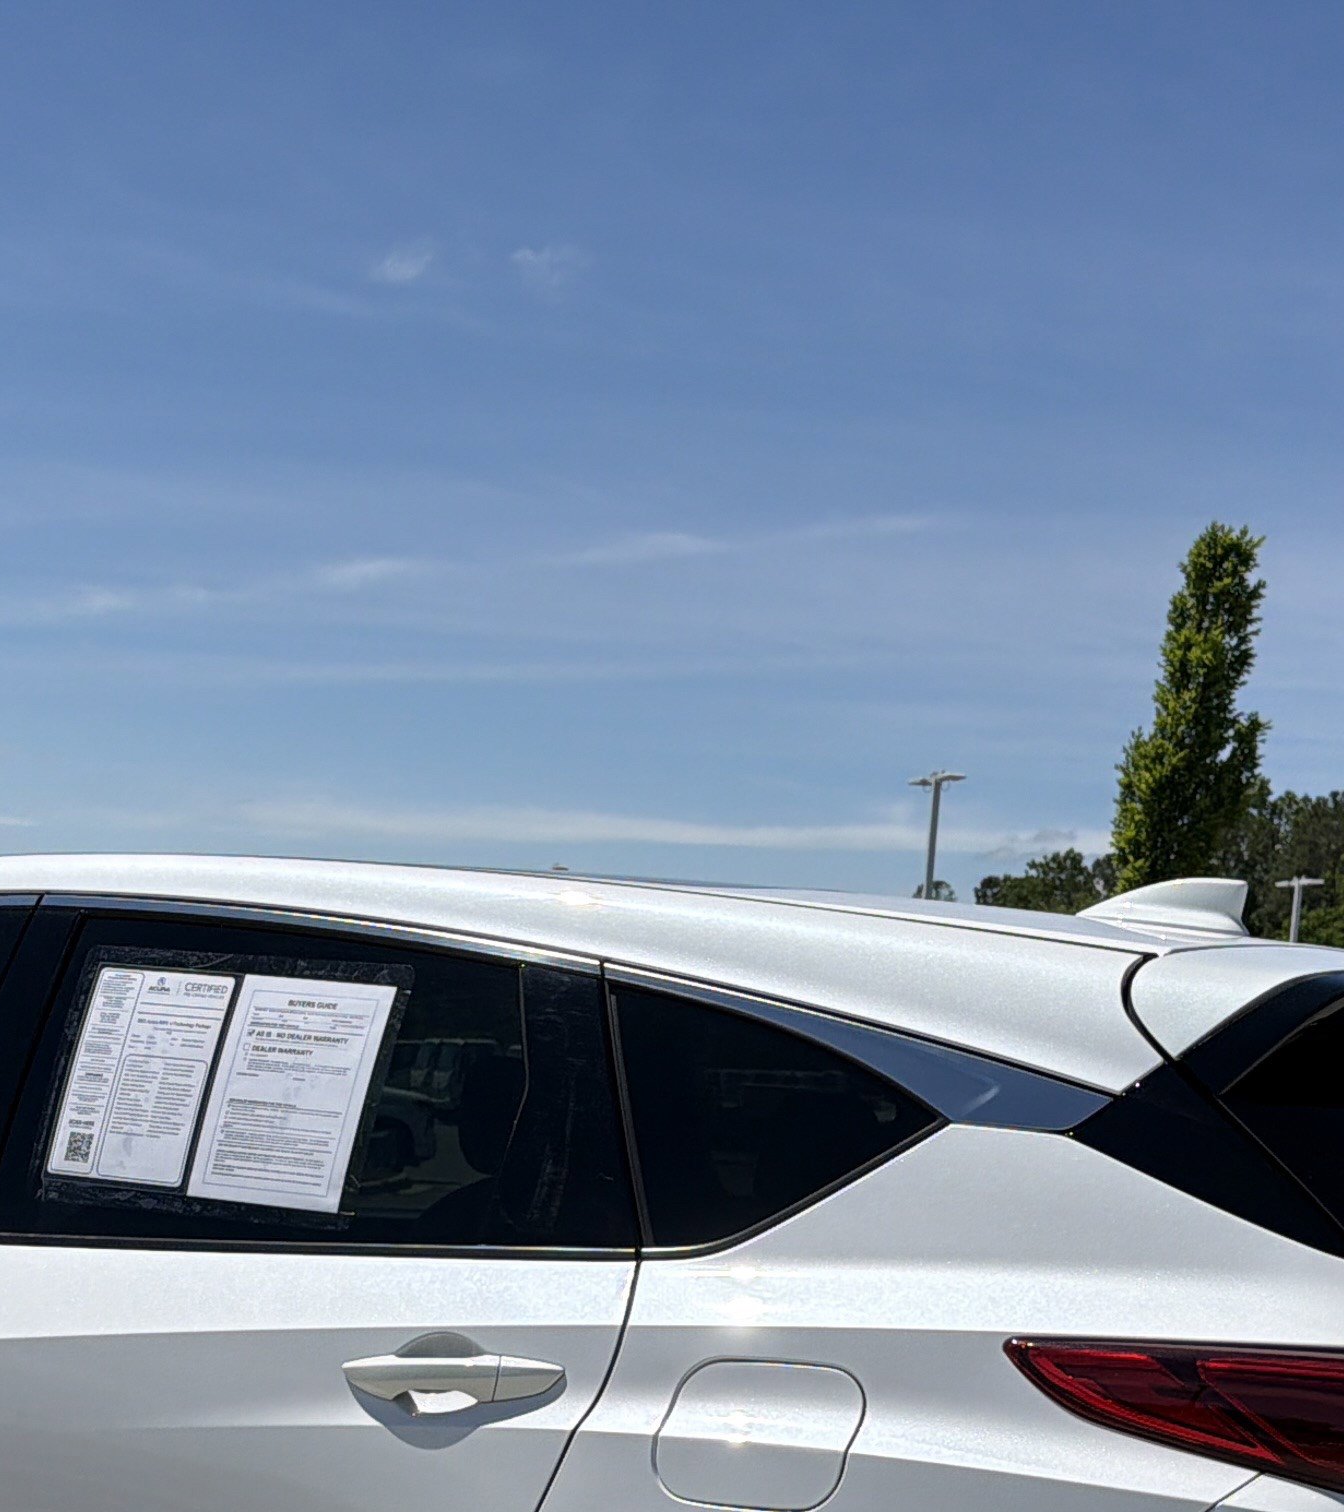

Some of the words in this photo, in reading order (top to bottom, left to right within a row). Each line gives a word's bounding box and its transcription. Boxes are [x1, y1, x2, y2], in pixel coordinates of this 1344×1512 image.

[184, 982, 229, 994] CERTIFIED
[287, 1000, 316, 1008] BUYERS
[316, 1002, 338, 1010] GUIDE
[313, 1035, 349, 1044] WARRANTY
[251, 1045, 278, 1053] DEALER
[278, 1046, 314, 1055] WARRANTY
